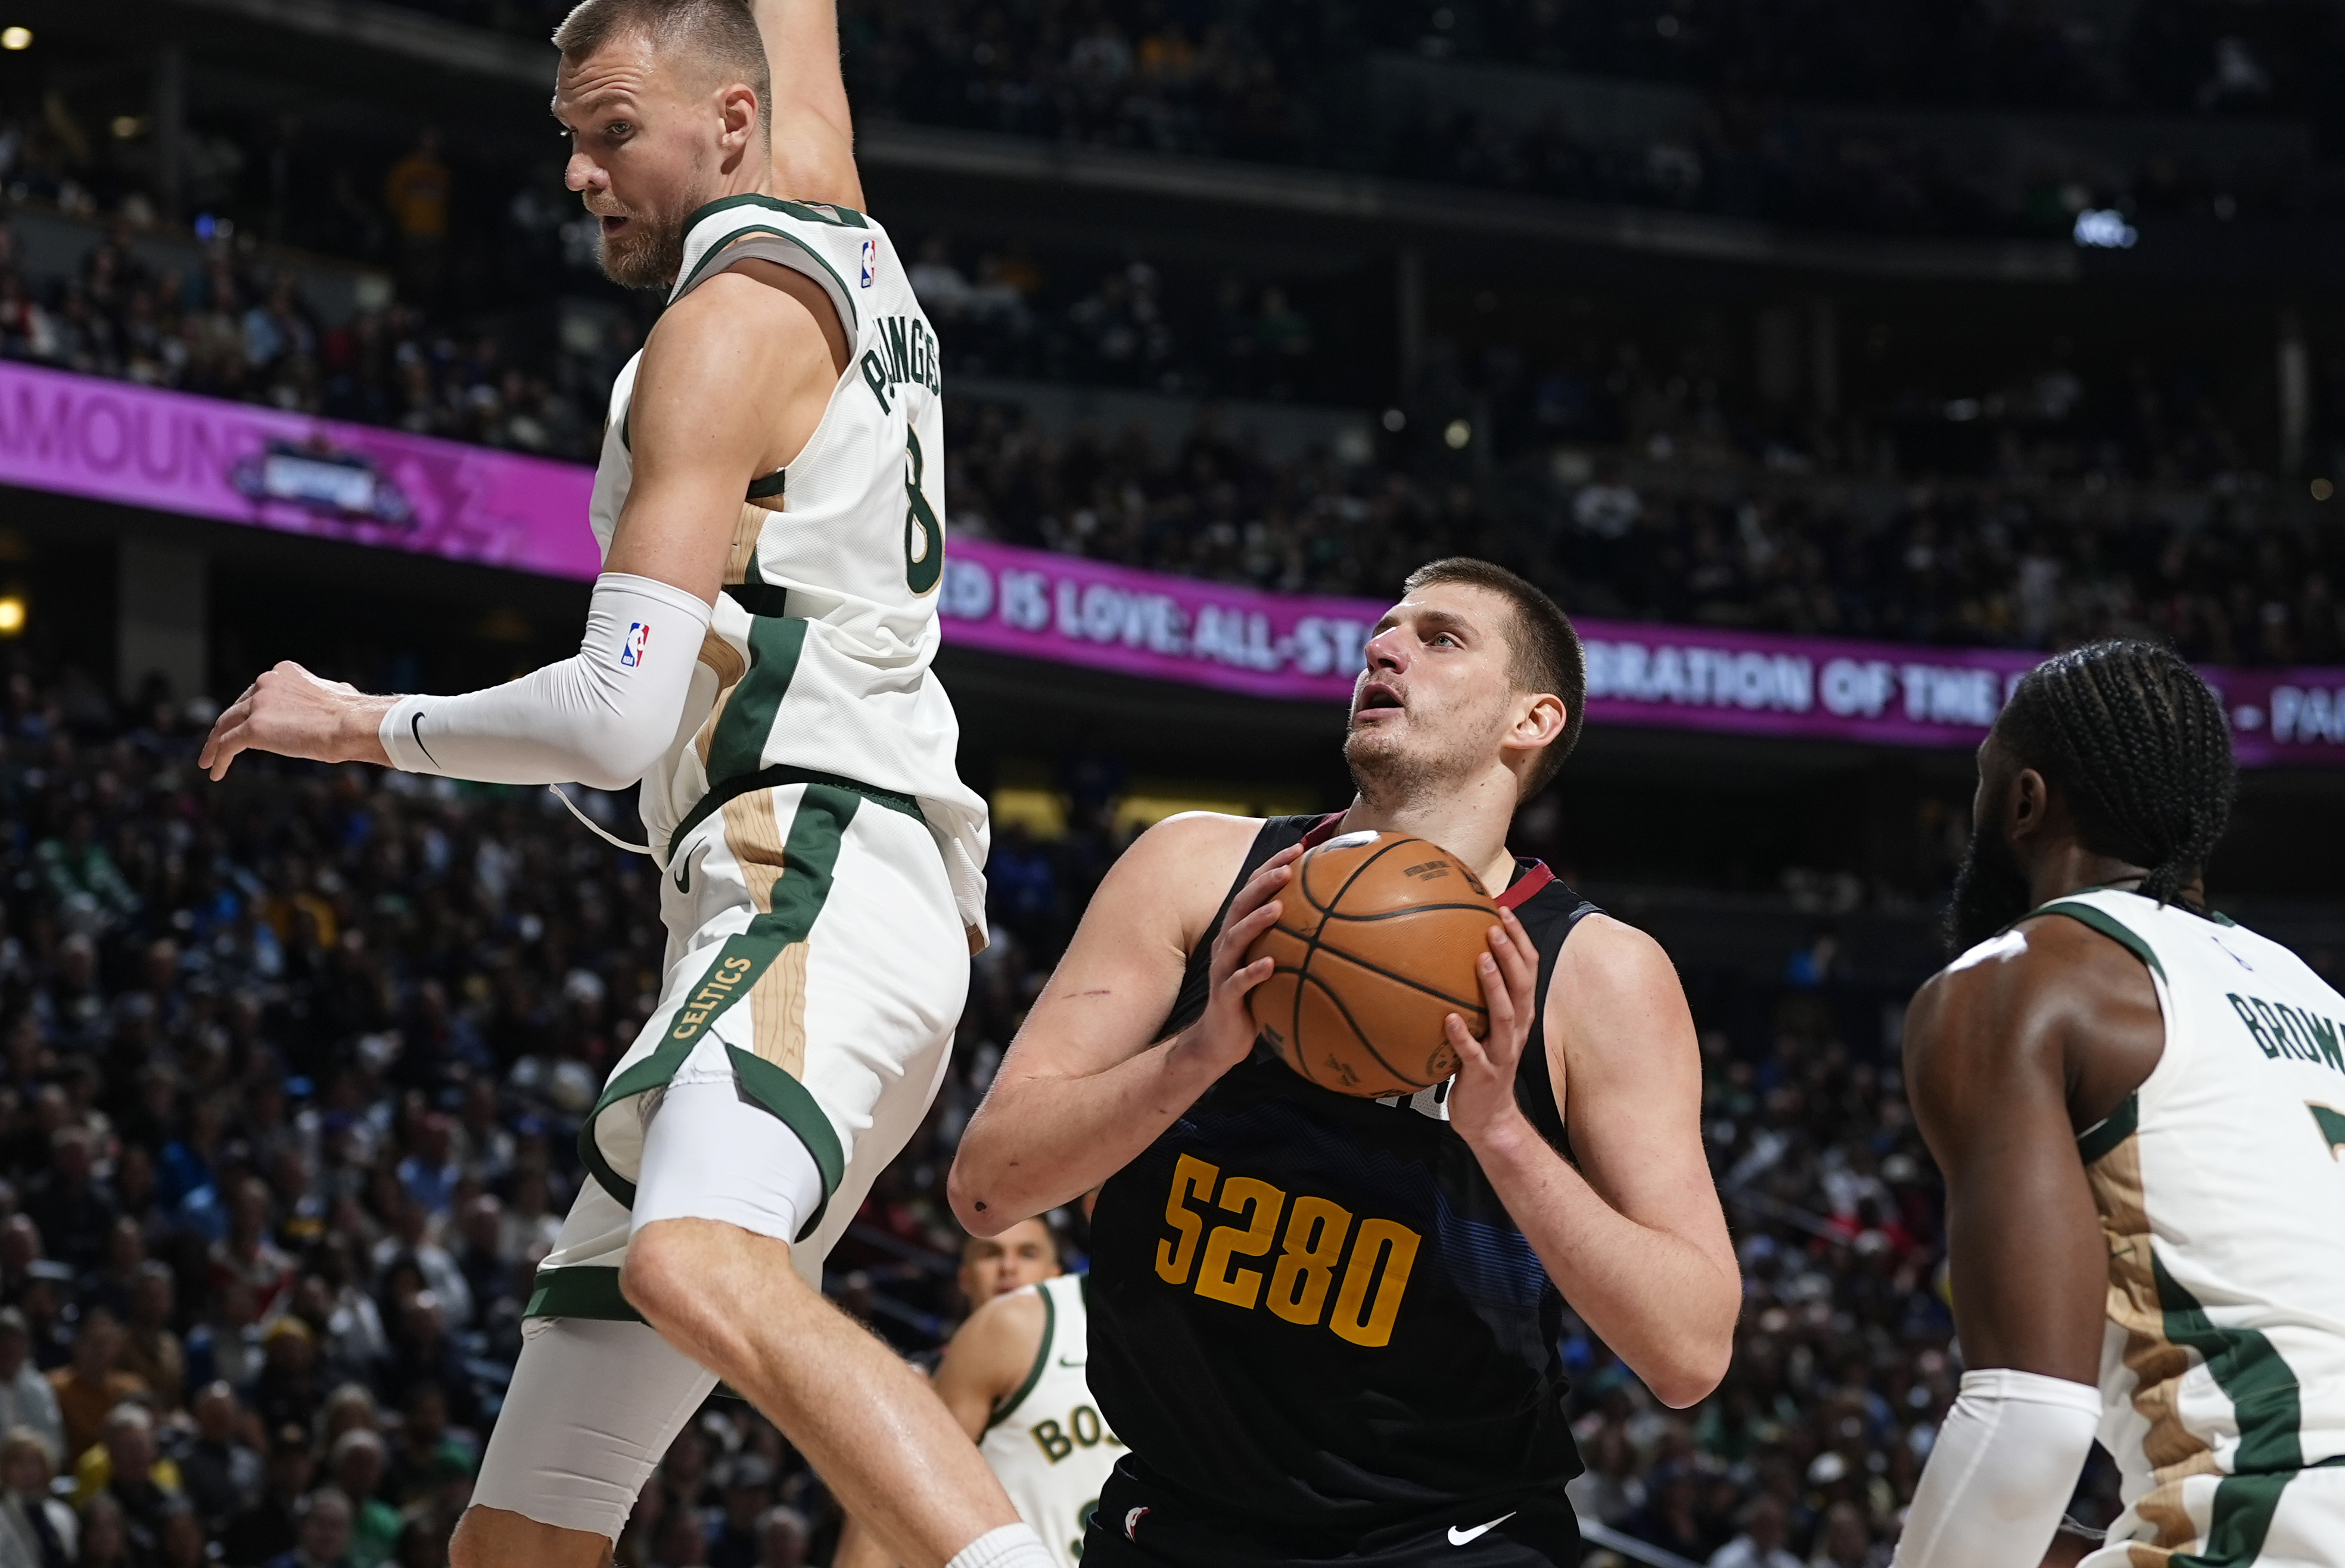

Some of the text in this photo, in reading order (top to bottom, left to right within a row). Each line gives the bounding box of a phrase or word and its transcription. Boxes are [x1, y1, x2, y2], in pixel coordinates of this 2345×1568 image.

[904, 418, 946, 598] 8
[1000, 568, 1051, 631] IS
[1193, 602, 1370, 677] ALL-ST
[1820, 658, 1895, 717] OF
[1901, 662, 2000, 727] THE
[673, 957, 751, 1040] CELTICS
[1155, 1153, 1422, 1348] 5280
[1030, 1404, 1125, 1466] BO
